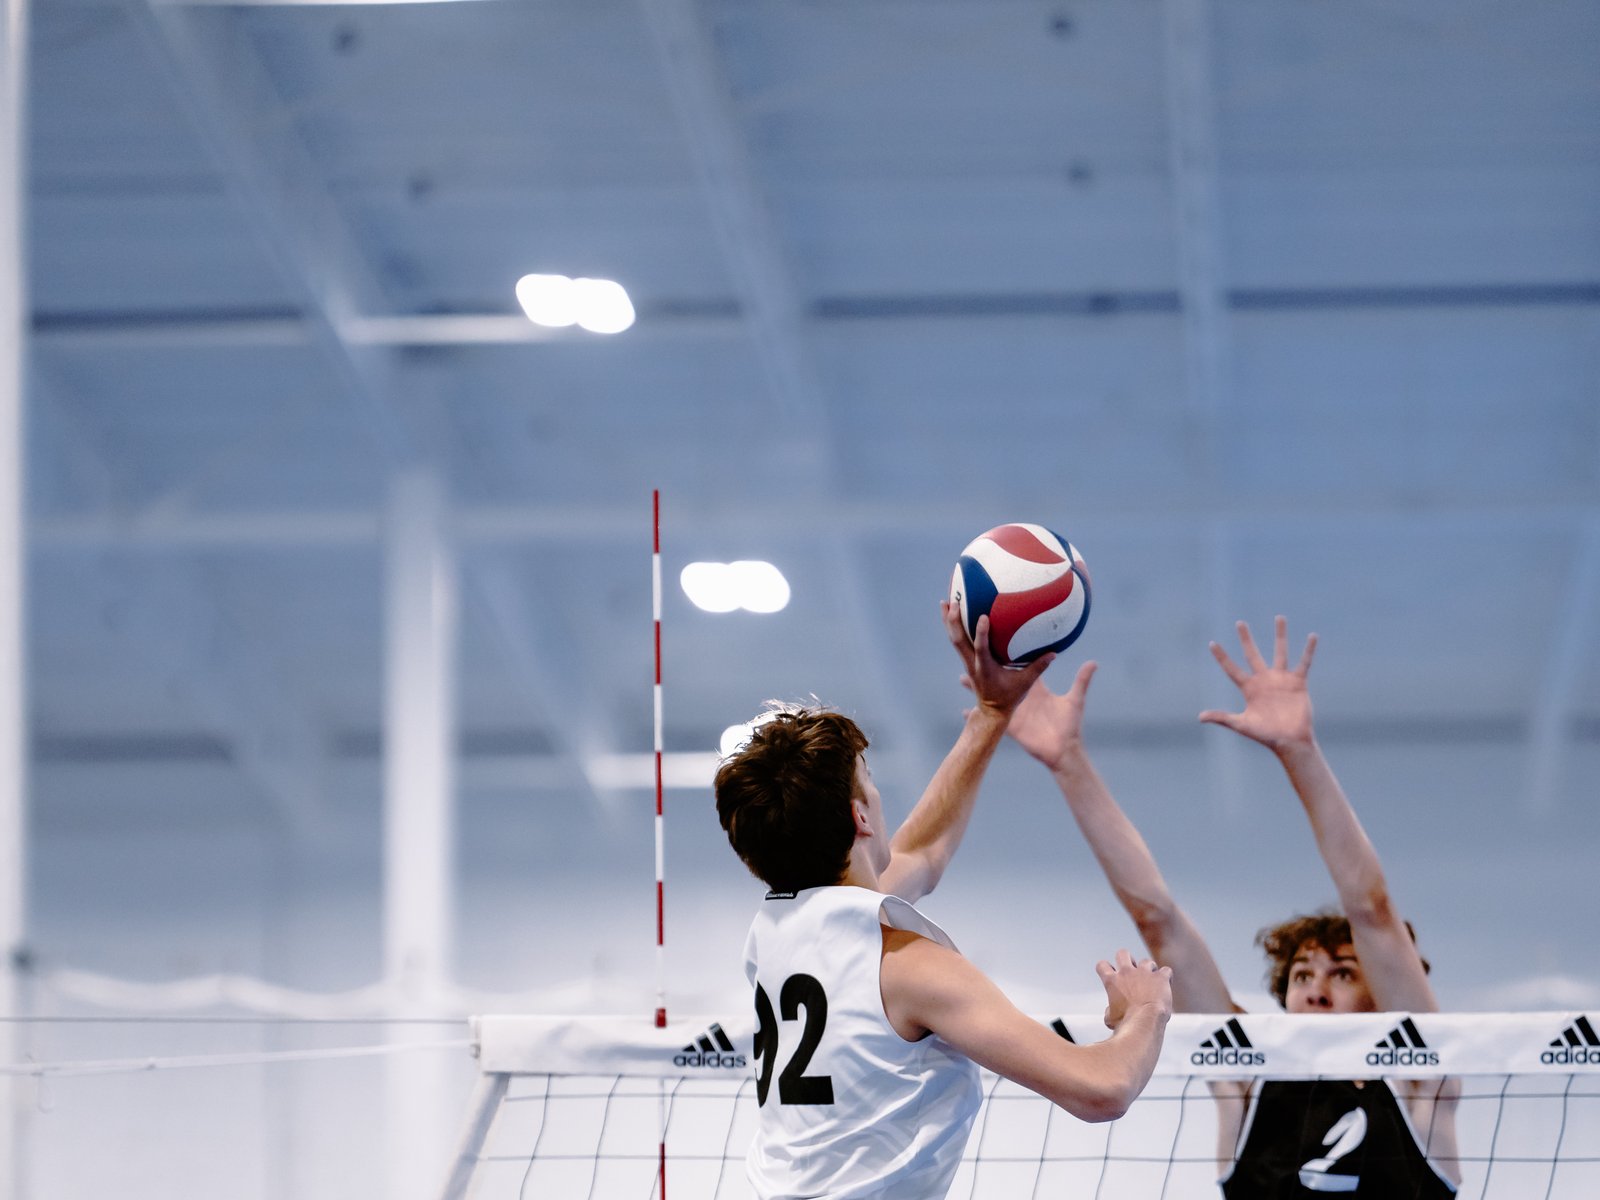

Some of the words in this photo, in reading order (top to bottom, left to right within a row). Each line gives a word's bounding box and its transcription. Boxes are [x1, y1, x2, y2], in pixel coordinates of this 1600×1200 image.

[673, 1052, 747, 1068] adidas
[1190, 1049, 1265, 1066] adidas
[1365, 1049, 1440, 1066] adidas
[1540, 1048, 1600, 1065] adida
[1299, 1106, 1367, 1192] 2
